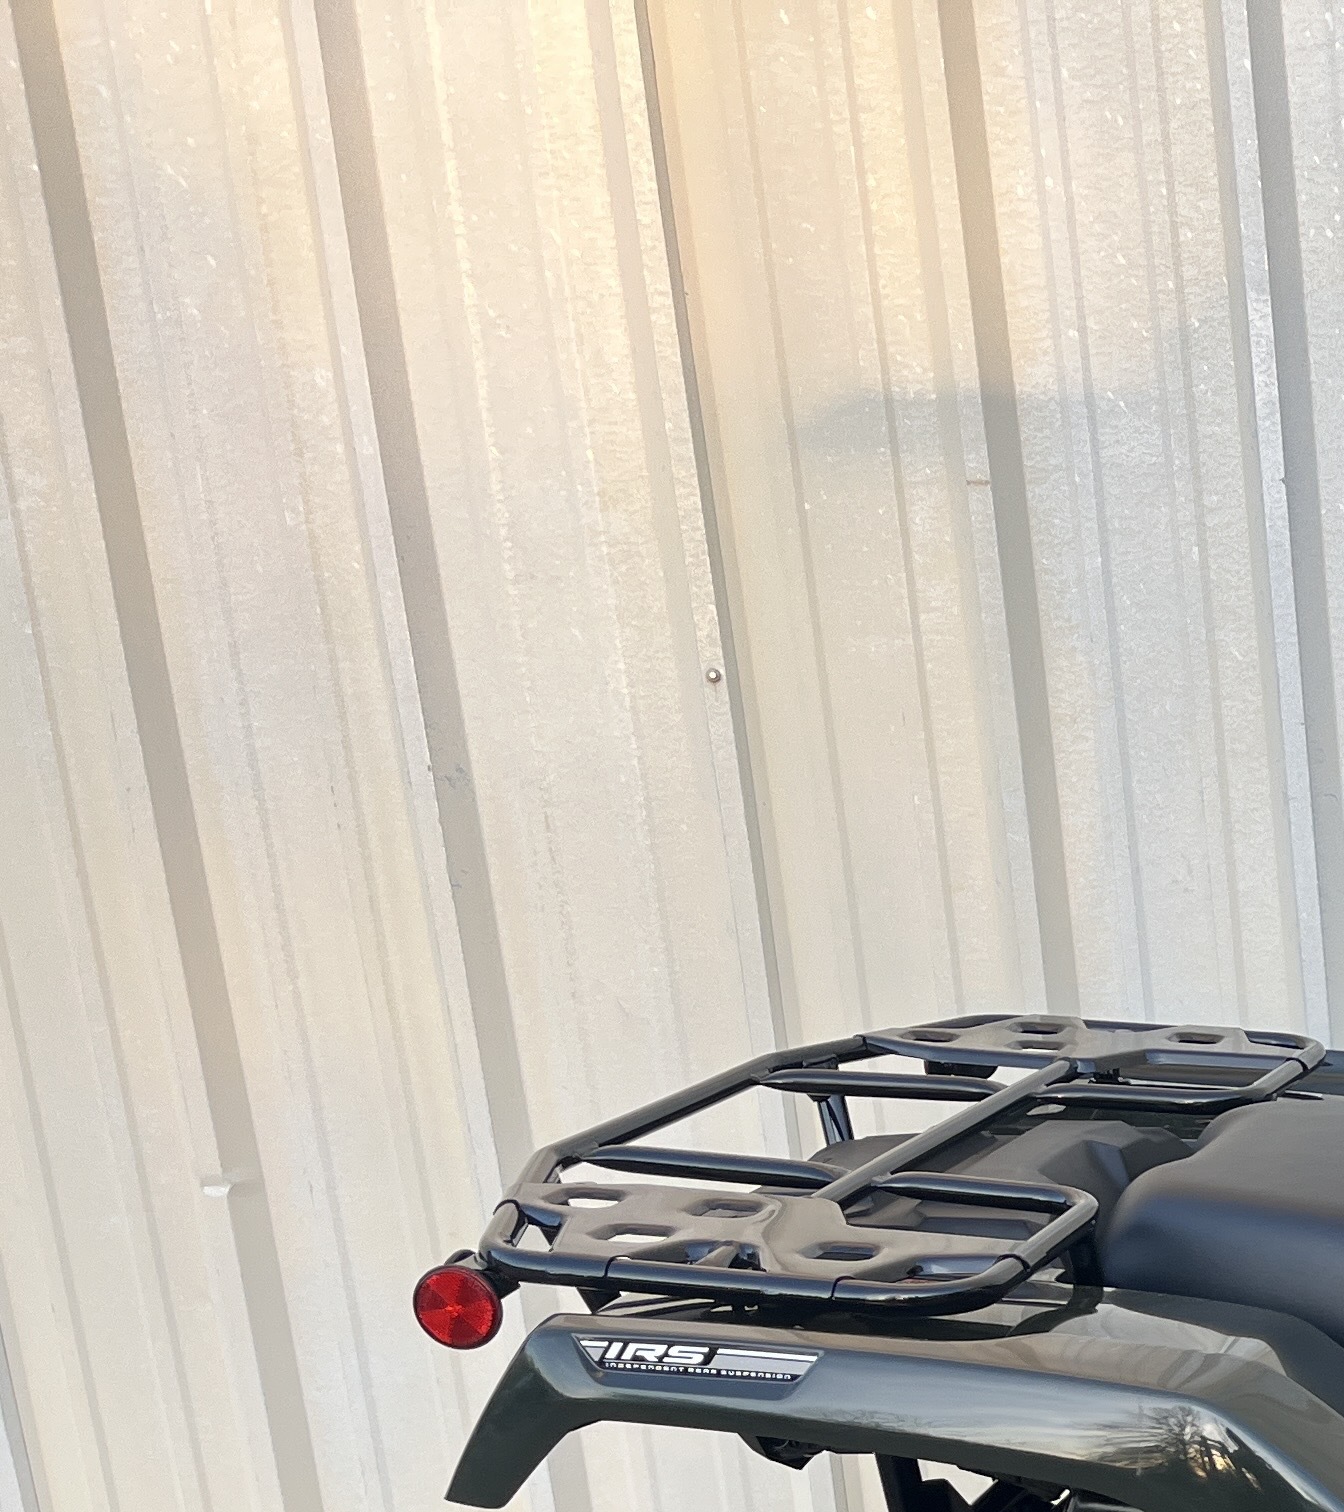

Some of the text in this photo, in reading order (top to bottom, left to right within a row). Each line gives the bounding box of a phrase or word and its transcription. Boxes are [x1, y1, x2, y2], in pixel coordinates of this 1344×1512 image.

[603, 1341, 709, 1365] IRS
[605, 1362, 792, 1380] INDEPENDENT REAR SUSPENSION
